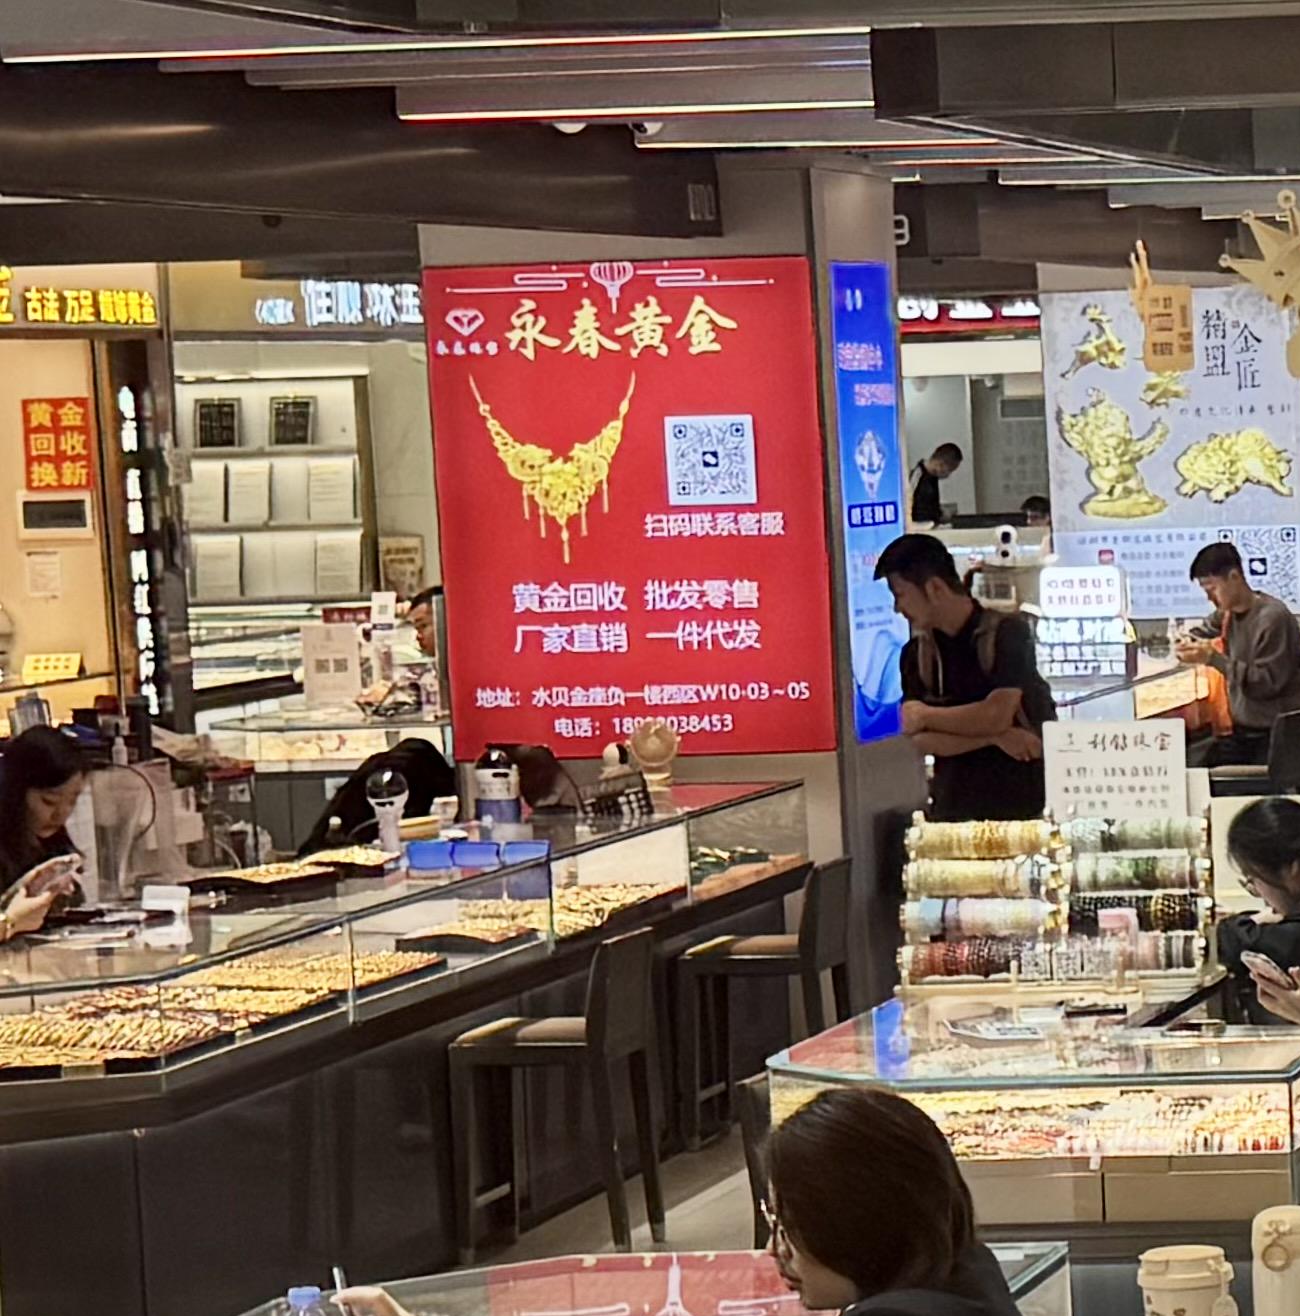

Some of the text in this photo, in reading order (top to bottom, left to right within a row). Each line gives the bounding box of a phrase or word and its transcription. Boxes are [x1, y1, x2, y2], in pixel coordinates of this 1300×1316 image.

[505, 294, 738, 361] 永春黄金
[28, 401, 84, 429] 黄金
[29, 432, 88, 457] 回收
[30, 460, 90, 488] 换新
[644, 511, 786, 539] 扫码联系客服
[512, 579, 760, 614] 黄金回收 批发零售
[514, 618, 761, 653] 厂家直销 一件代发
